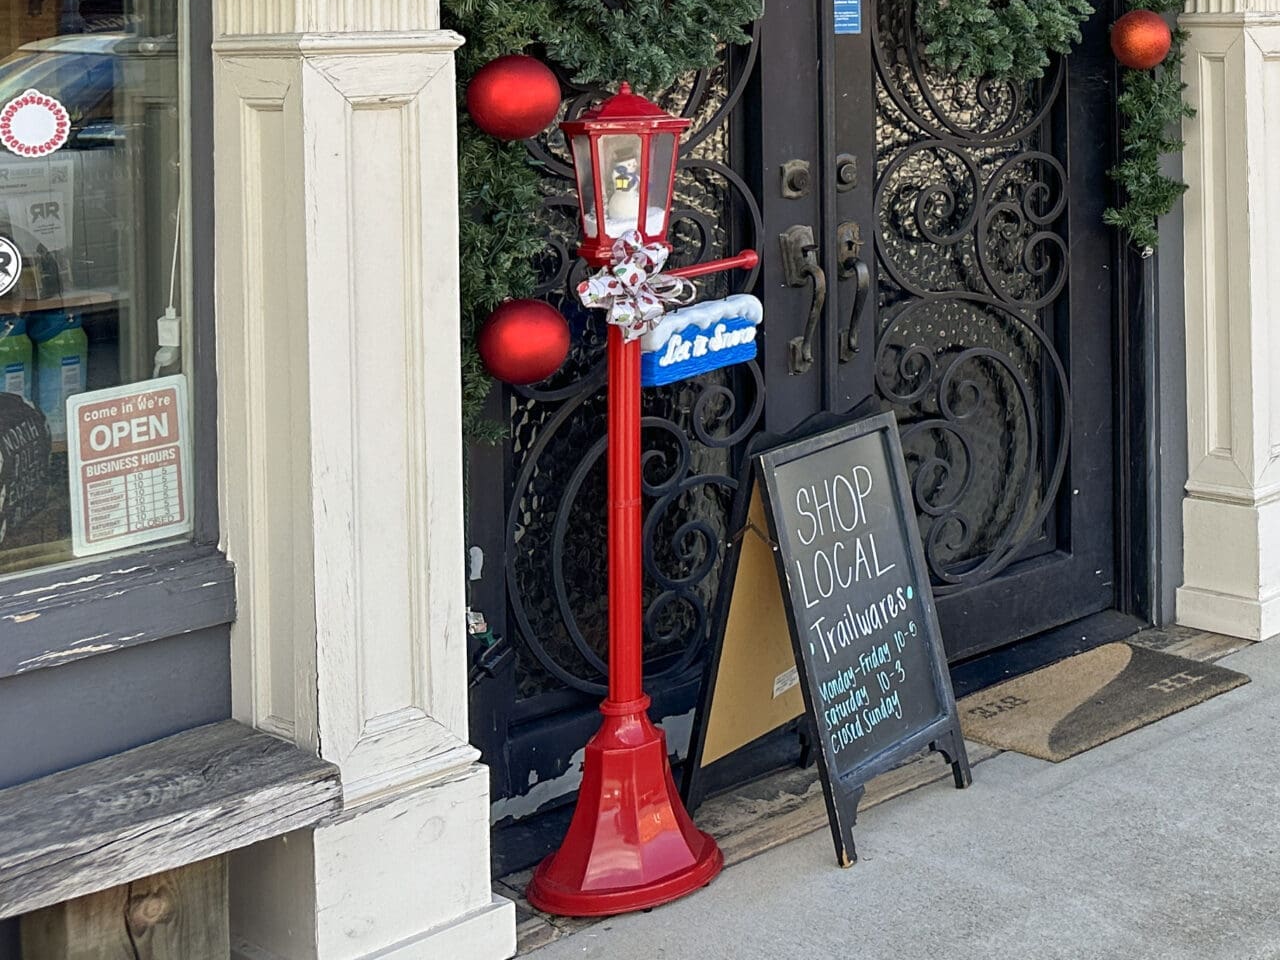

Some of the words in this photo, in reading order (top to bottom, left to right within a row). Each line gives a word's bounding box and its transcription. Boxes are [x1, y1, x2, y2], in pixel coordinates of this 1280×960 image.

[659, 333, 692, 367] Let
[708, 323, 757, 352] Snow
[84, 406, 118, 422] come
[121, 402, 133, 414] in
[89, 412, 169, 452] OPEN
[86, 455, 139, 478] BUSINESS
[141, 448, 176, 466] HOURS
[796, 465, 873, 545] SHOP
[796, 533, 896, 609] LOCAL
[810, 587, 906, 663] Trailwares
[893, 620, 918, 654] 10-5
[877, 660, 906, 694] 10-3
[862, 690, 903, 733] Sunday
